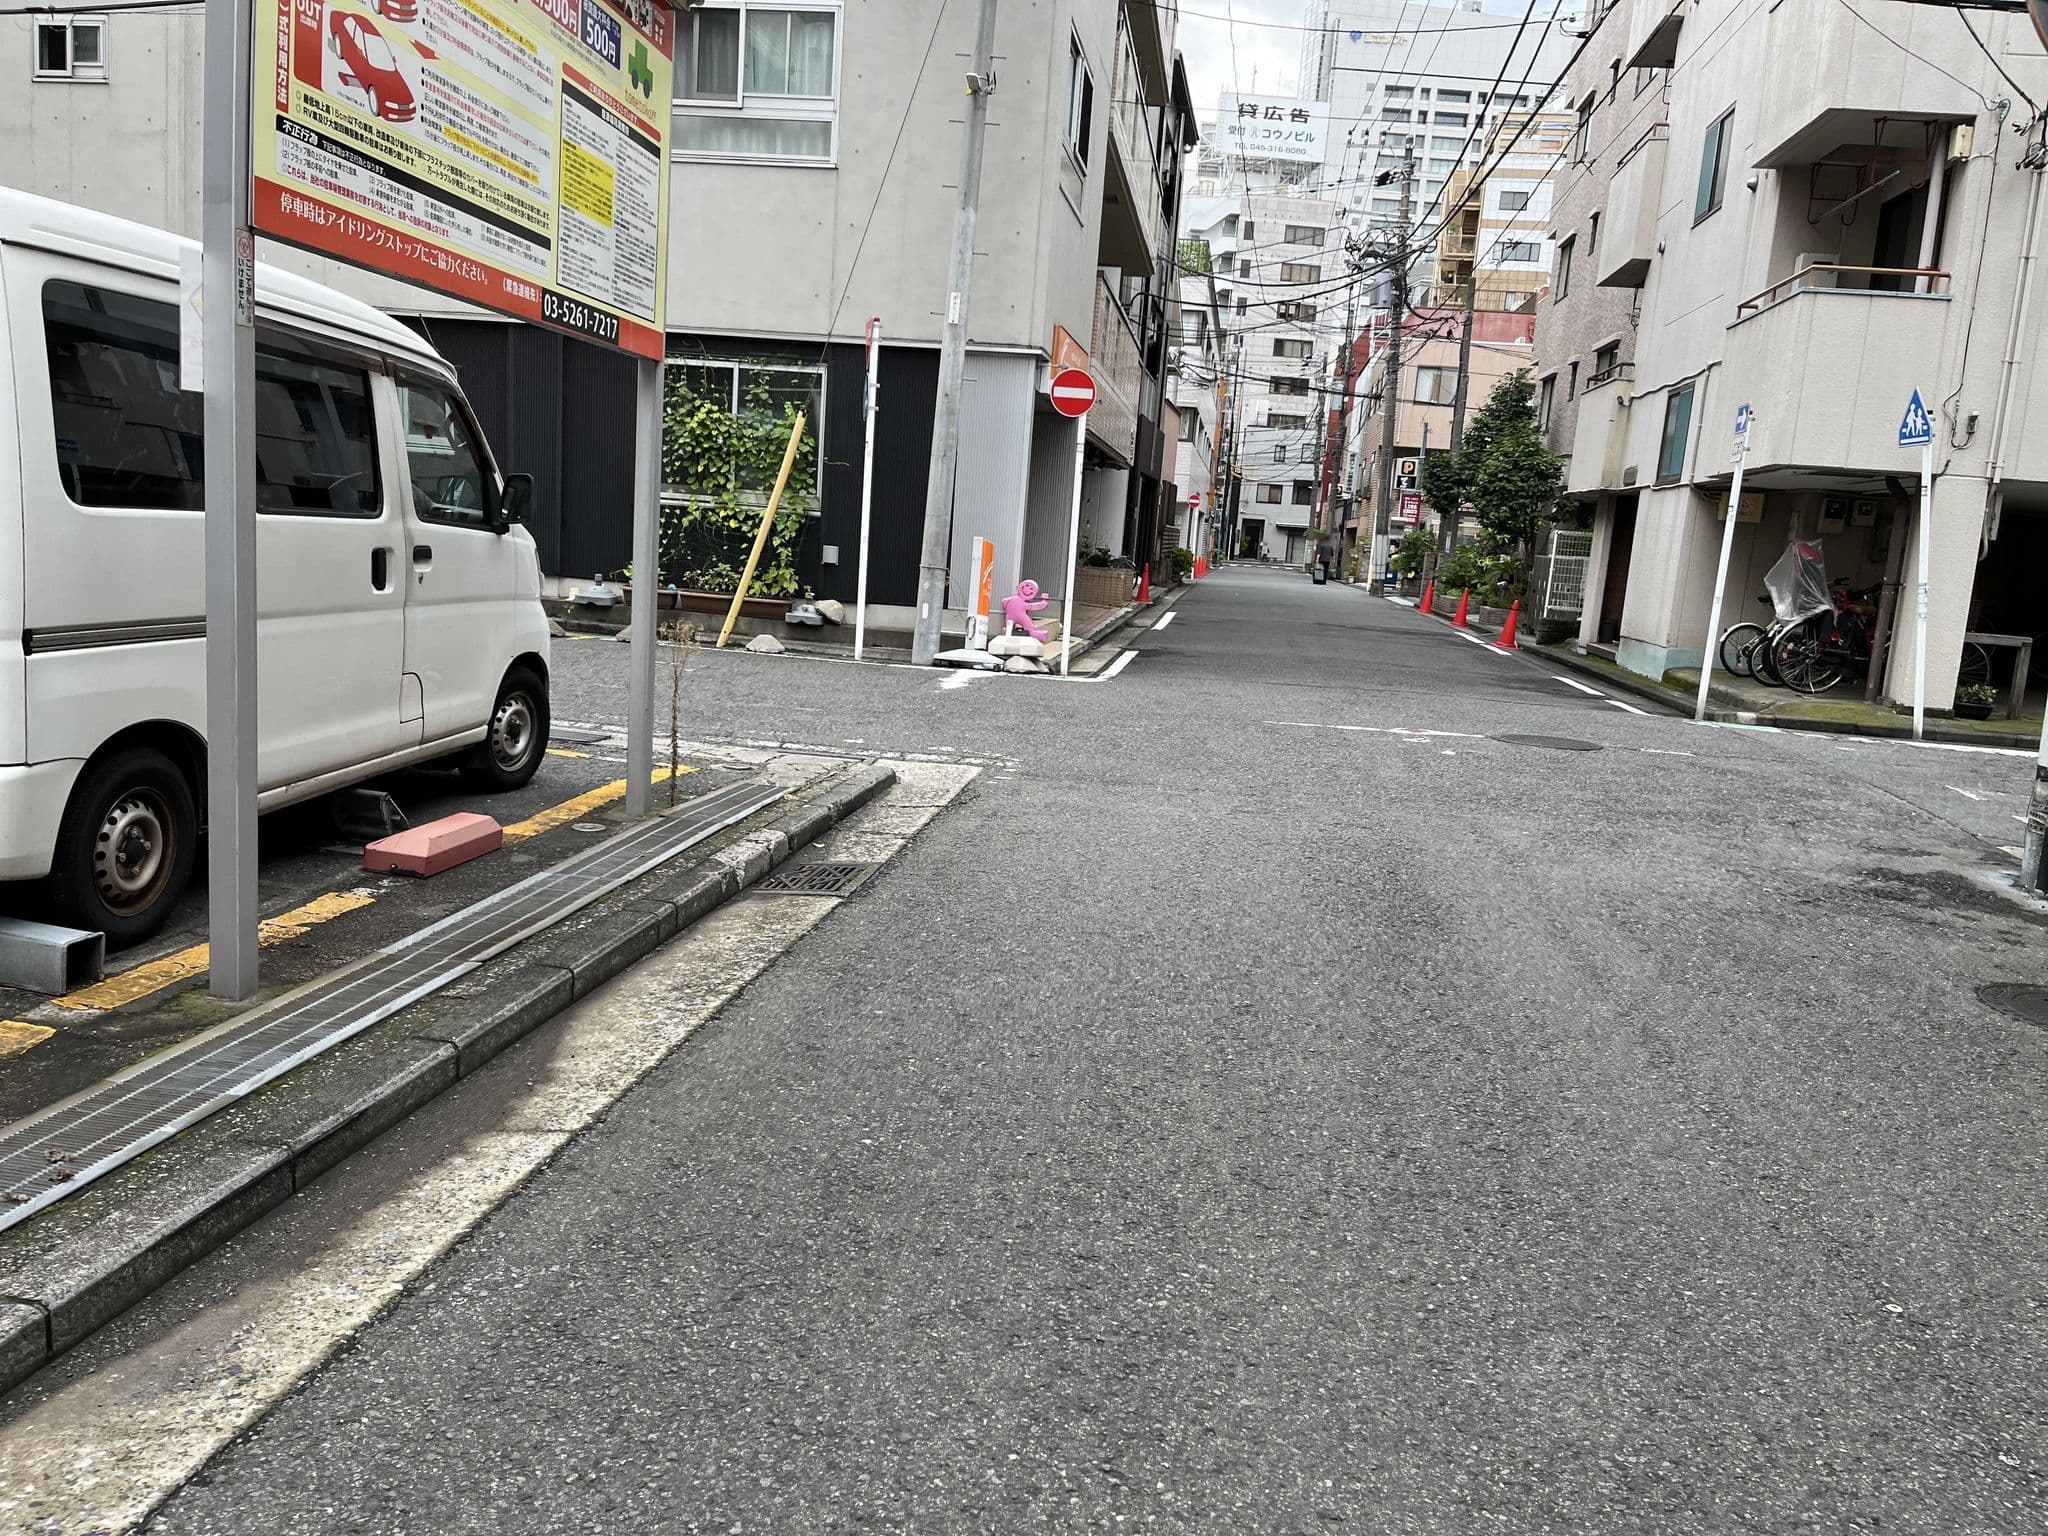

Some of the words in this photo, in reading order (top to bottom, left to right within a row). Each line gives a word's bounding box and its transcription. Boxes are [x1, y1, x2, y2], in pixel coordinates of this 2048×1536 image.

[295, 0, 322, 23] OUT
[586, 14, 615, 65] 500円
[1238, 103, 1311, 124] 貸広告
[281, 117, 318, 147] 不正行為
[1227, 125, 1246, 136] 受付
[1234, 142, 1248, 151] TEL
[280, 191, 488, 286] 停車時はアイドリングストップにご協力ください。
[543, 293, 618, 340] 03-5261-7217
